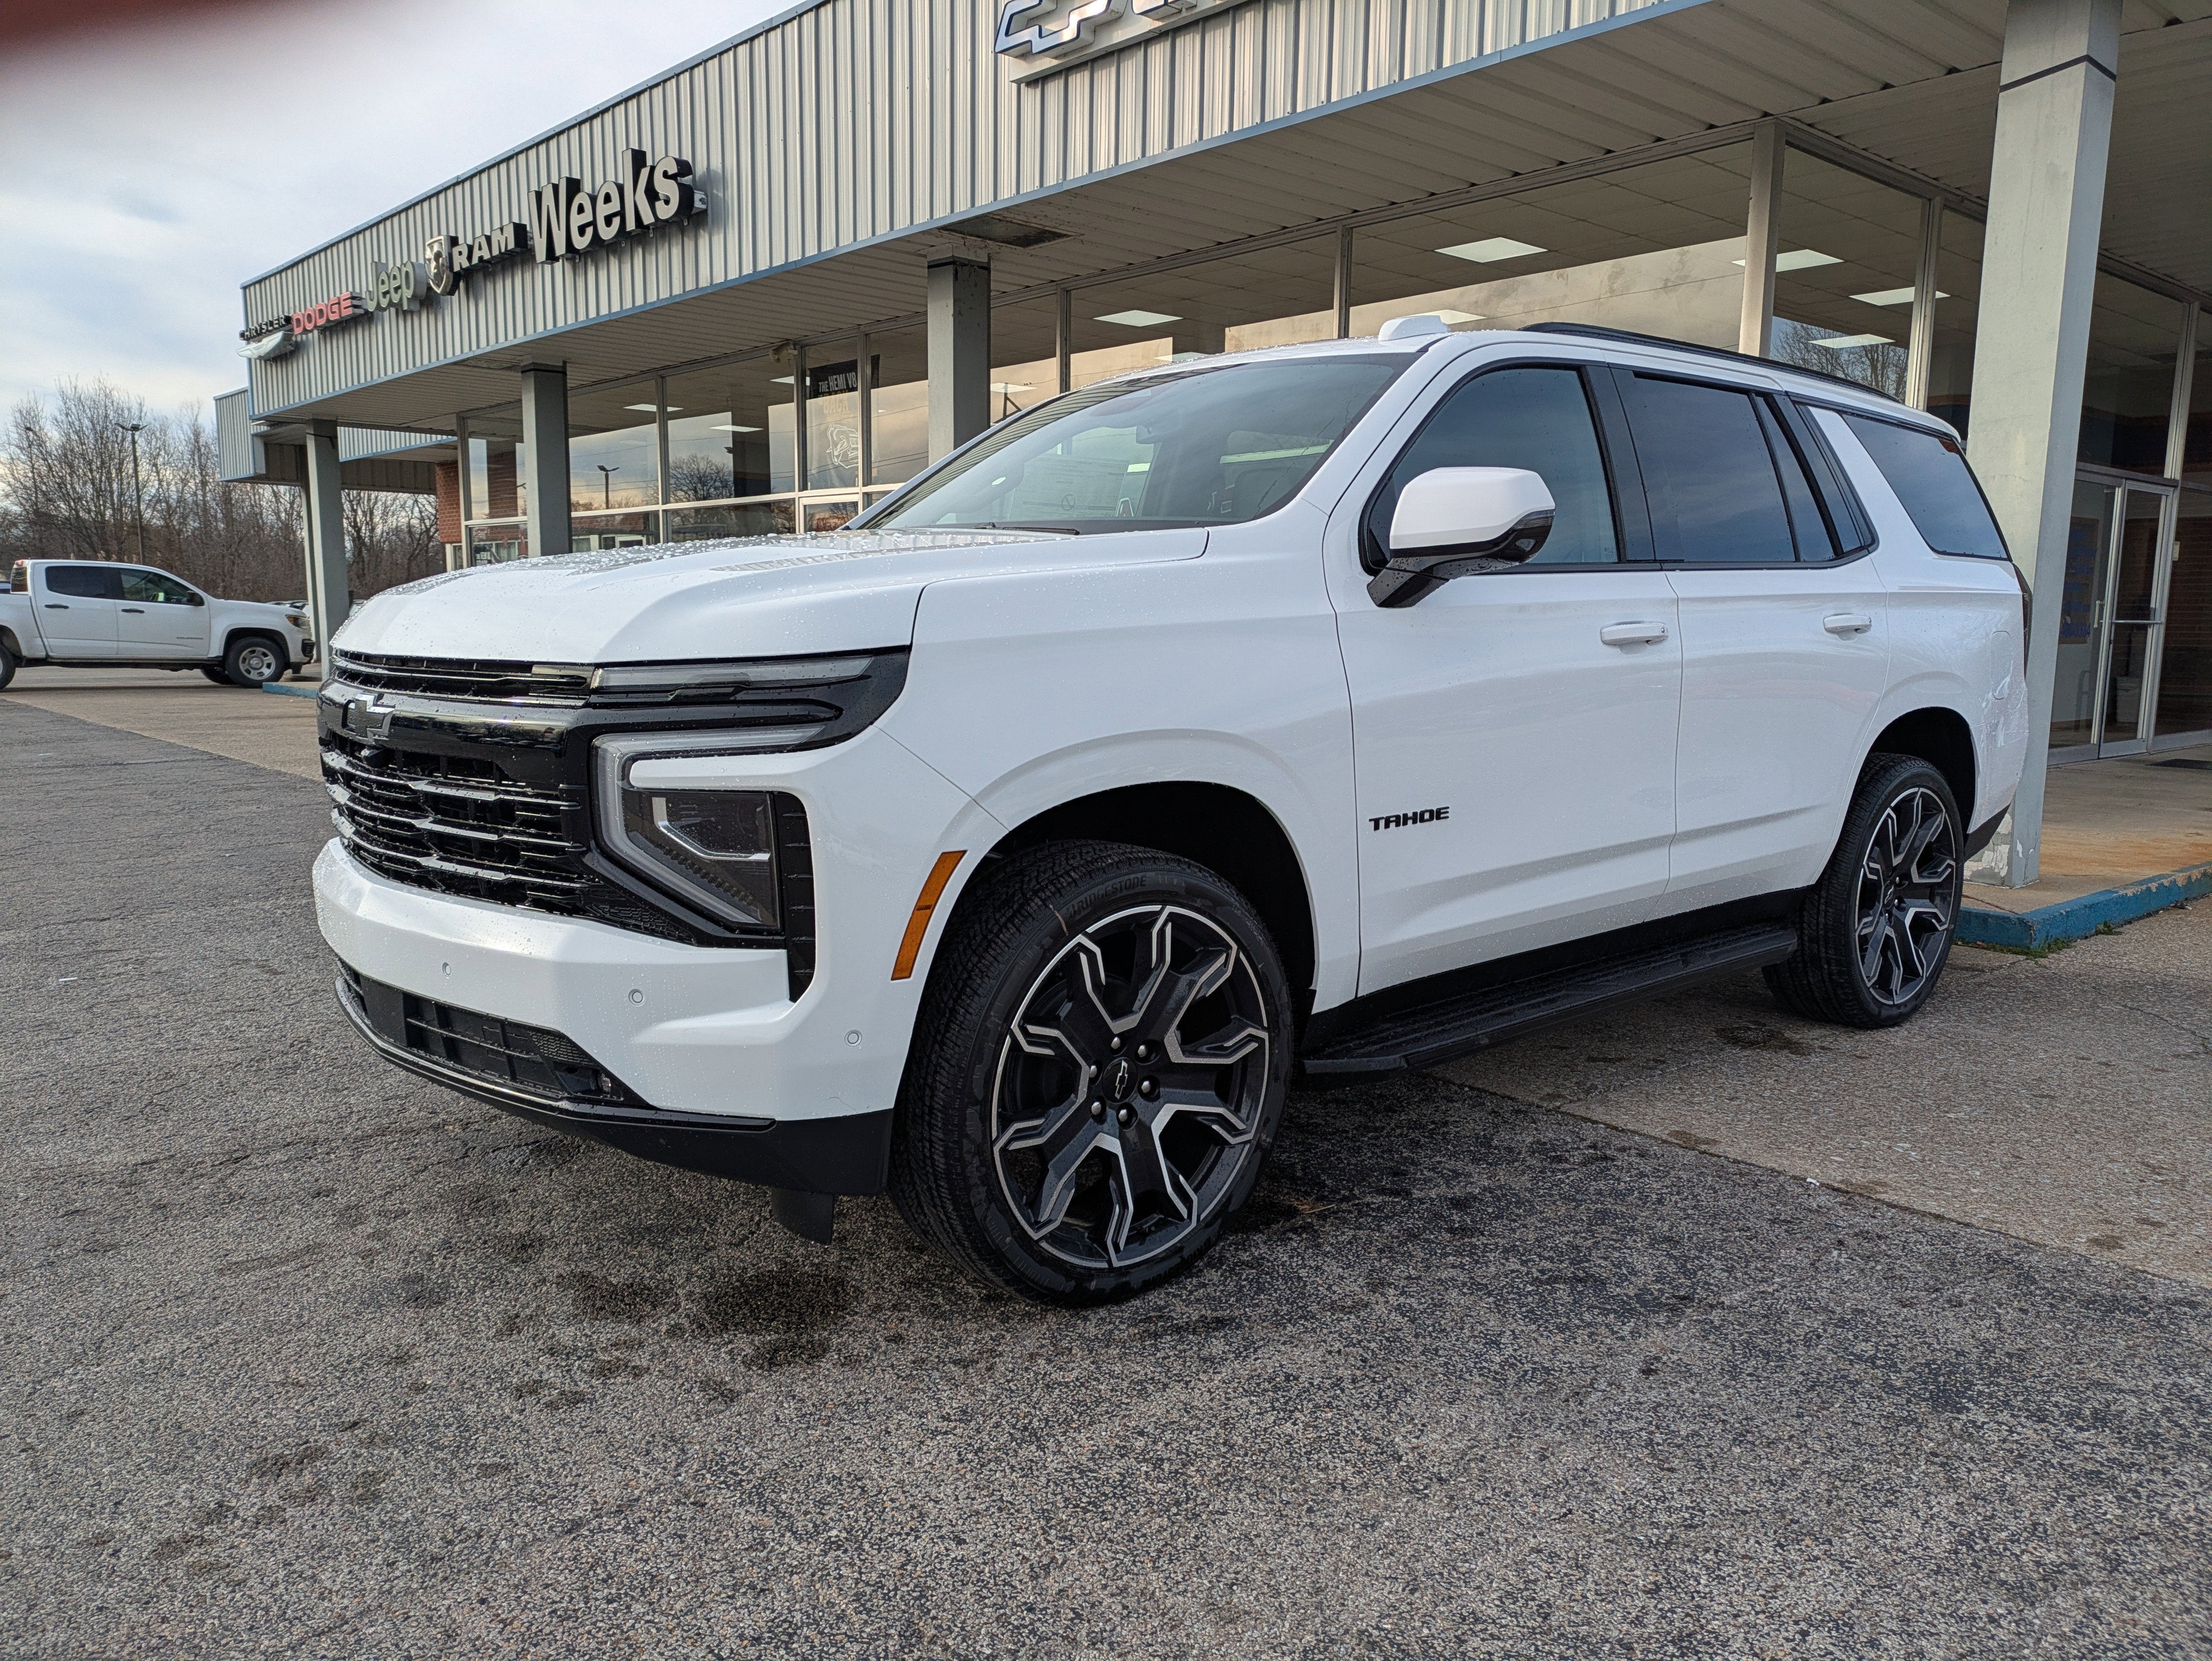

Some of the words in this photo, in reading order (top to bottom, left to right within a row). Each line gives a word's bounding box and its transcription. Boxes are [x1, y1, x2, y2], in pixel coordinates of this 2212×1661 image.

[528, 148, 692, 264] Weeks
[452, 223, 524, 273] RAM
[365, 261, 422, 312] Jeep
[239, 314, 286, 341] CHRYSLER
[292, 290, 354, 335] DODGE
[818, 381, 829, 392] THE
[829, 374, 846, 391] HEMI
[847, 372, 857, 388] V8
[1369, 806, 1449, 831] TAHOE
